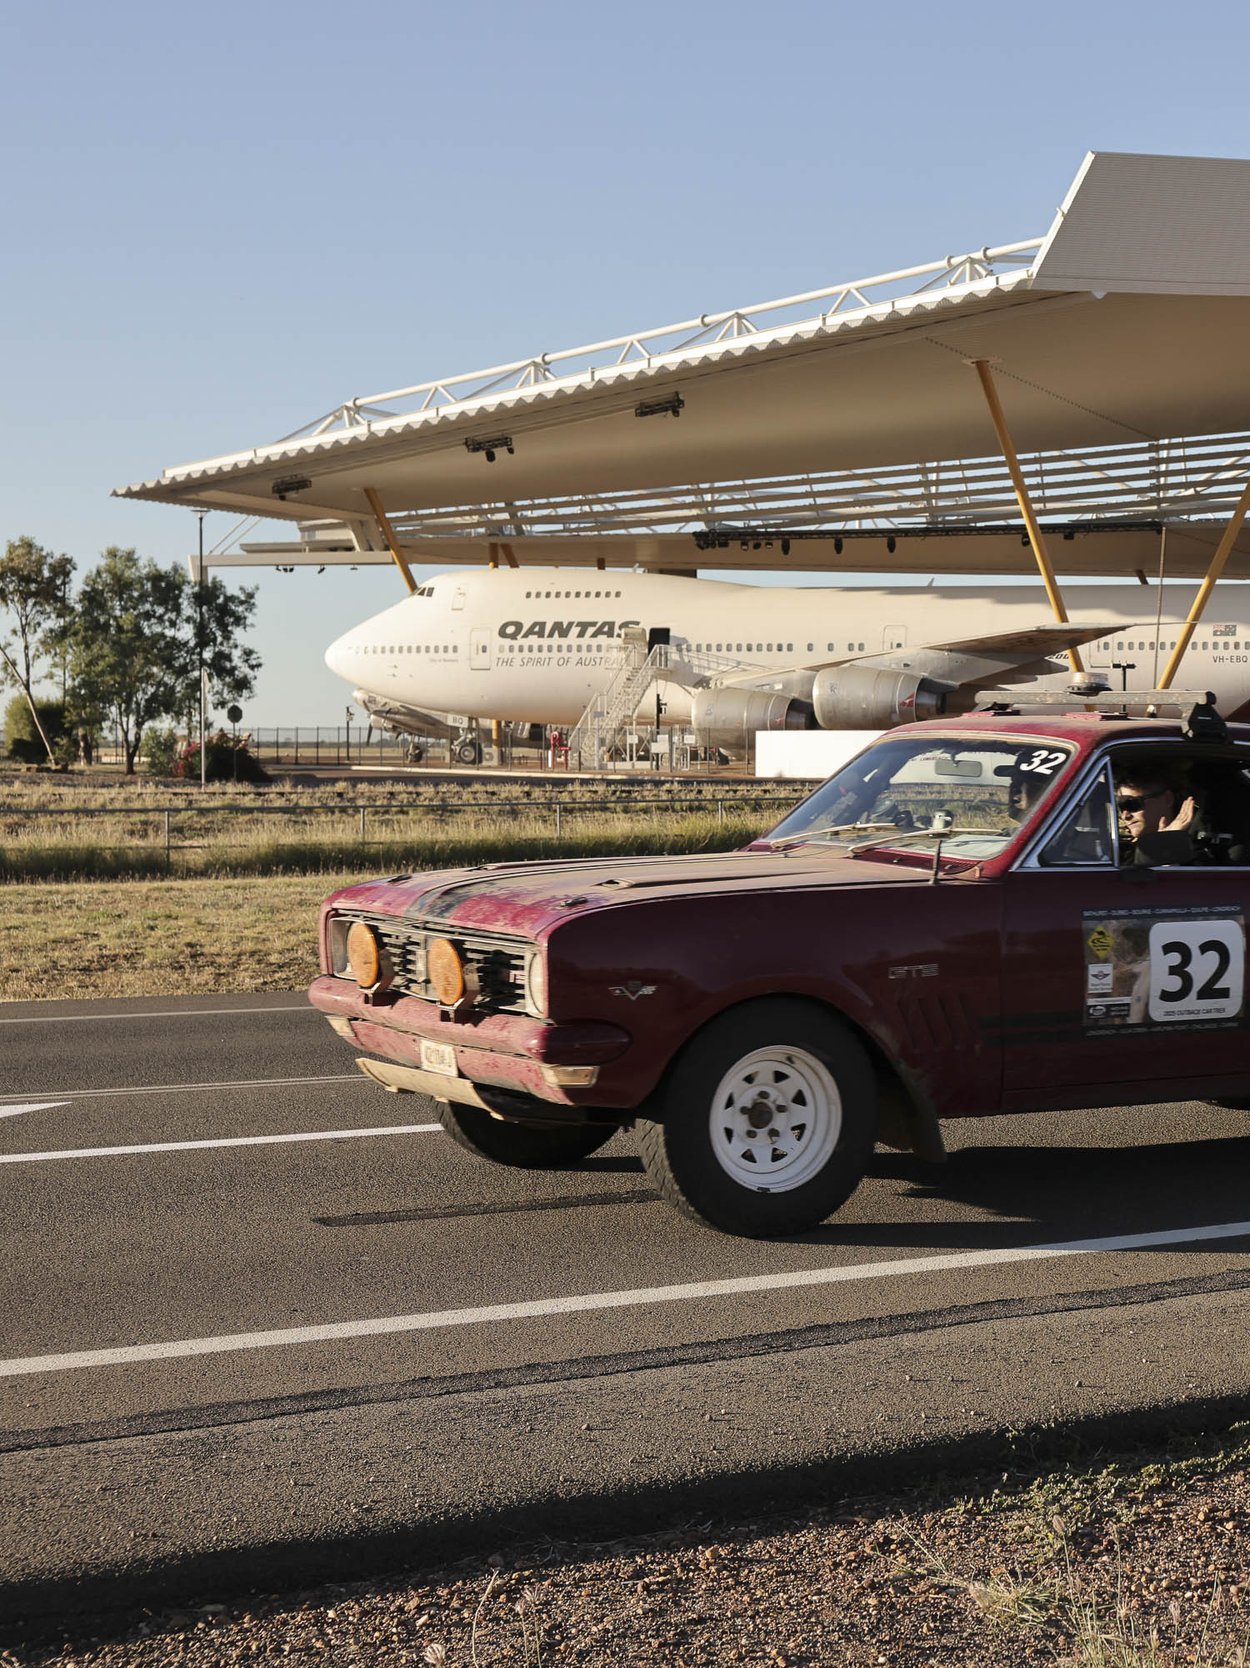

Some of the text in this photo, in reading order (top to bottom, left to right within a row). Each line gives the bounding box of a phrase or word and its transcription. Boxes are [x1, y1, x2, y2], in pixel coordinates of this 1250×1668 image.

[496, 656, 516, 667] THE
[520, 656, 554, 667] SPIRIT
[557, 656, 571, 667] OF
[1212, 655, 1248, 663] VH-EBQ
[1019, 749, 1067, 775] 32
[1158, 939, 1231, 1003] 32
